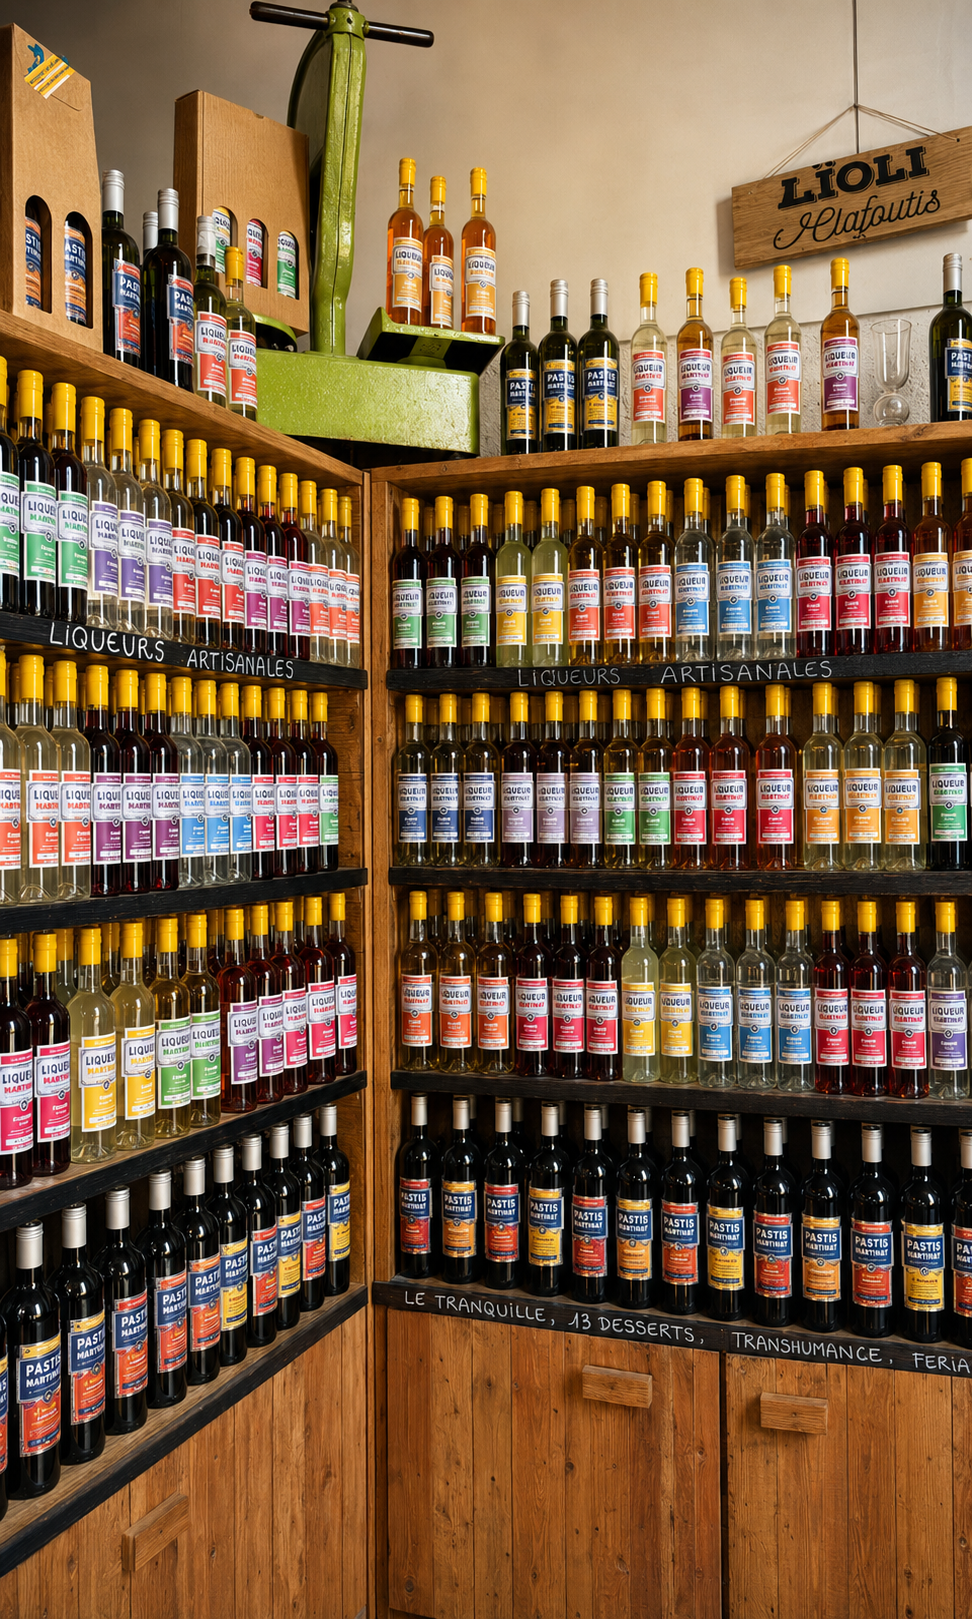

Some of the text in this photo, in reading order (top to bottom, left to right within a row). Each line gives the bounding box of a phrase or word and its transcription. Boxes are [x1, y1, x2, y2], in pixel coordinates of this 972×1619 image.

[50, 622, 294, 678] LIQUEURS ARTISANALES
[518, 660, 833, 687] LIQUEURS ARTISANALES
[664, 1216, 694, 1228] PASTIS
[710, 1220, 740, 1232] PASTIS
[756, 1227, 788, 1240] PASTIS
[806, 1230, 837, 1243] PASTIS
[856, 1236, 888, 1248] PASTIS
[907, 1238, 941, 1252] PASTIS
[404, 1290, 425, 1306] LE
[434, 1295, 555, 1327] TRANQUILLE,
[568, 1313, 591, 1330] 13
[598, 1316, 704, 1344] DESSERTS,
[732, 1331, 894, 1364] TRANSHUMANCE,
